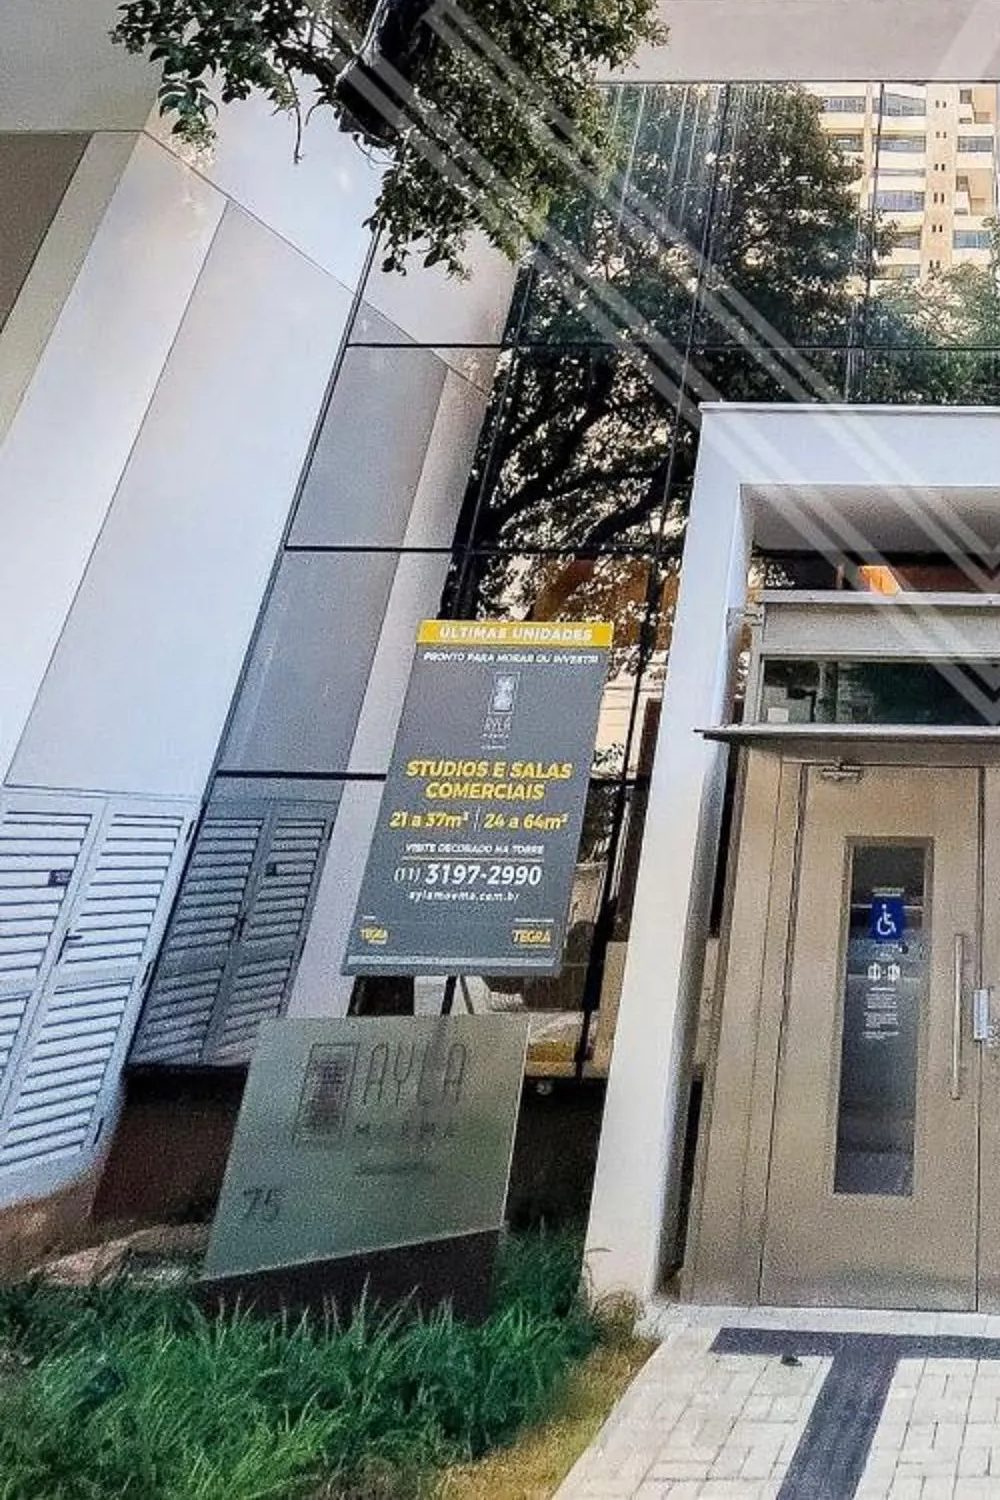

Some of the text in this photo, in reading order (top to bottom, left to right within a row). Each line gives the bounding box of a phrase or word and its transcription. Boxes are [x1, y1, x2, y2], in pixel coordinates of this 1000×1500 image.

[512, 628, 593, 642] UNIDADES
[467, 653, 495, 663] PARA
[406, 760, 573, 779] STUDIOS E SALAS
[425, 783, 545, 800] COMERCIAIS
[389, 812, 408, 828] 21
[411, 816, 421, 828] a
[483, 813, 506, 829] 24
[508, 817, 519, 829] a
[394, 864, 542, 885] (11) 3197-2990
[512, 929, 551, 943] TEGRA
